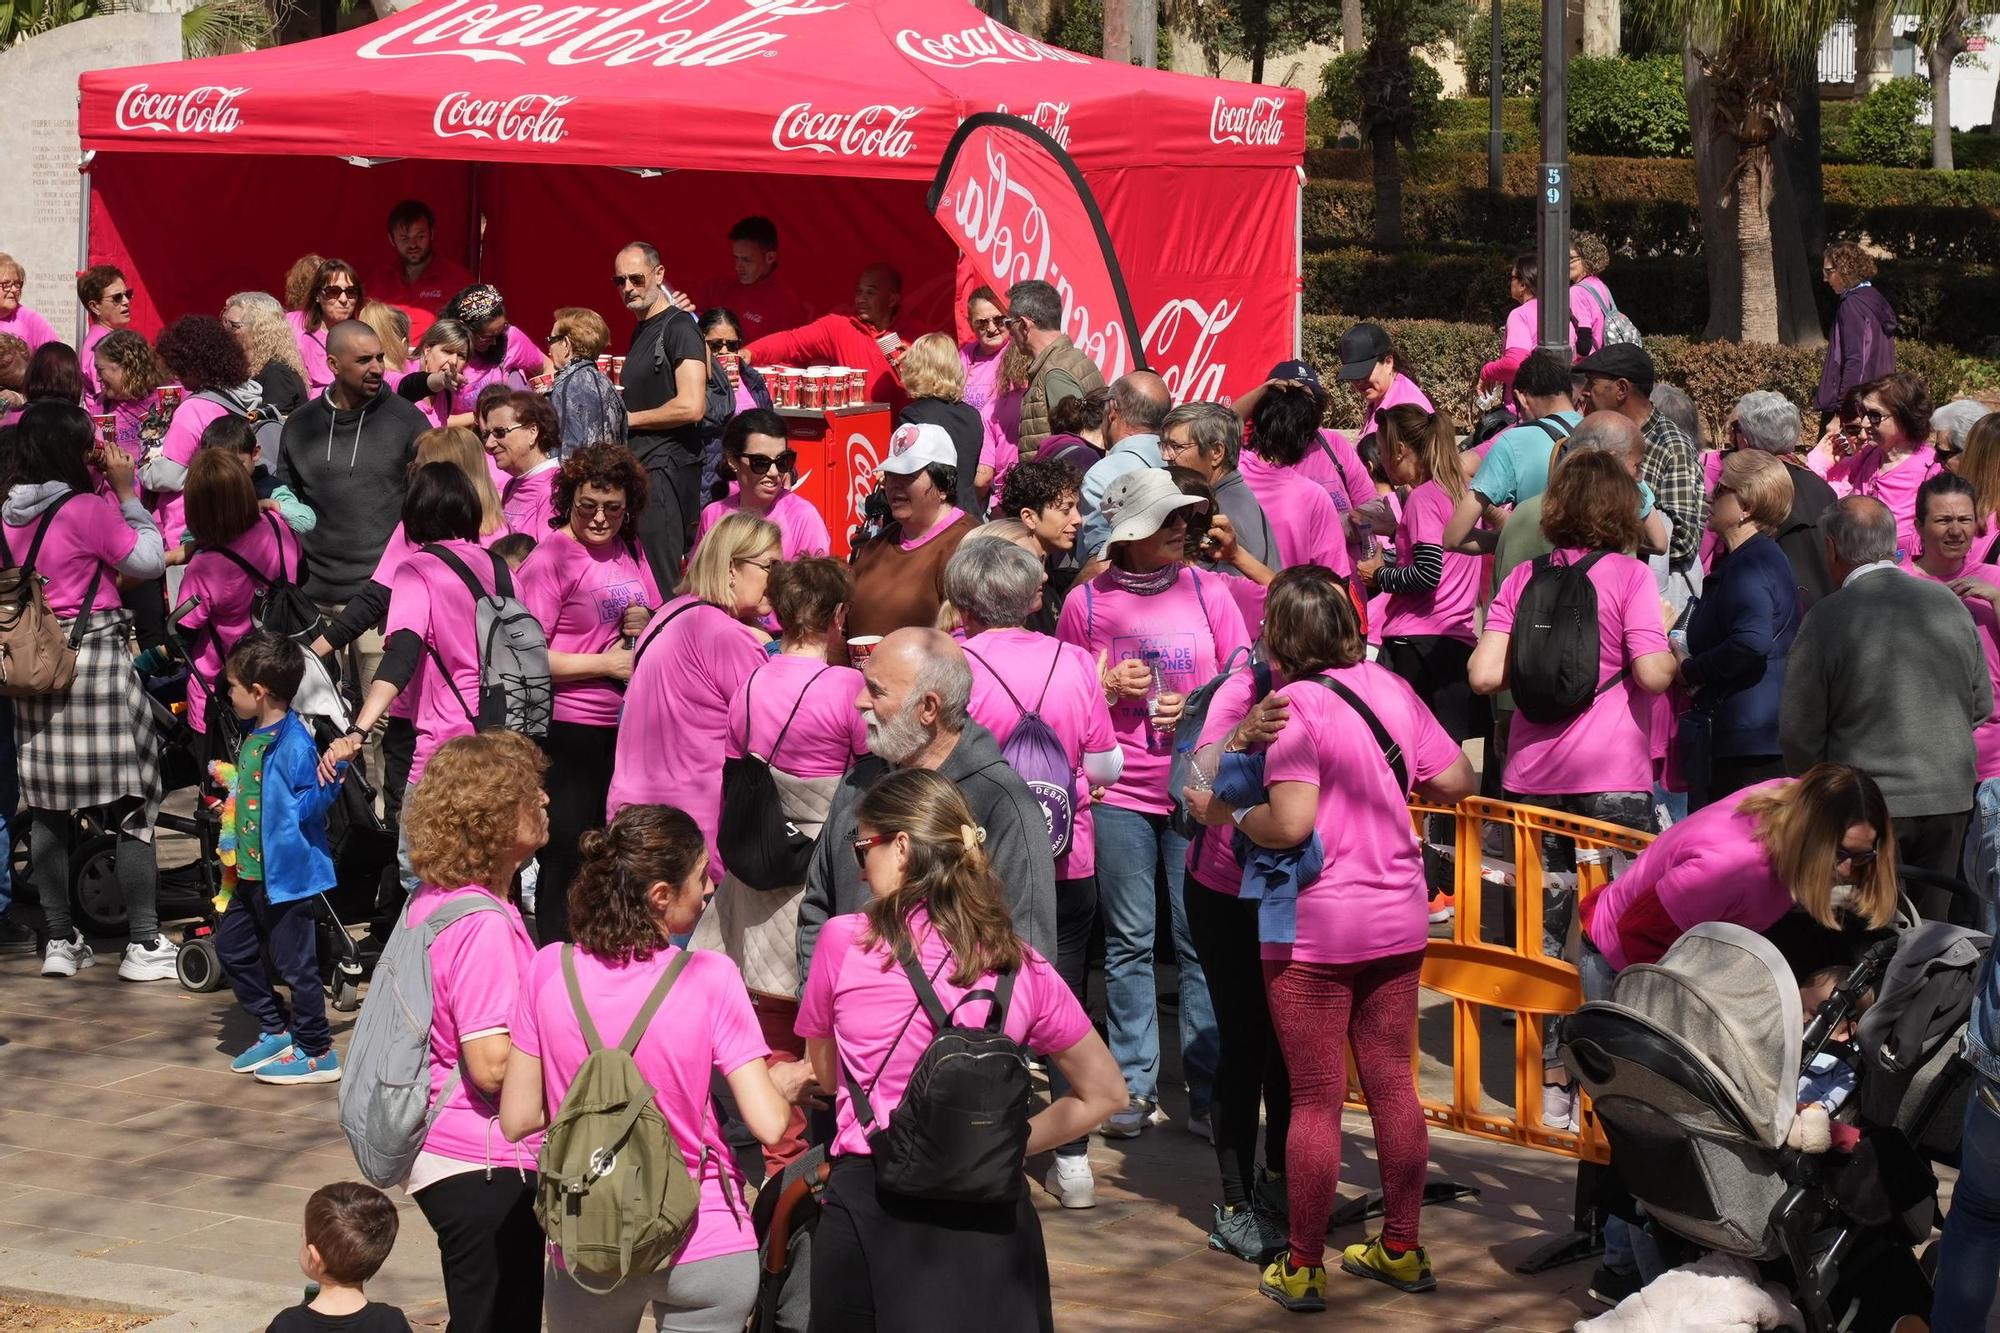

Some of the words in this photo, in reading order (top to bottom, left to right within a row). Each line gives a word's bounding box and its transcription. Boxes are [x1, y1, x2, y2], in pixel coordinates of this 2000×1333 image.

[356, 0, 790, 67] Coca-Cola
[115, 83, 252, 133] Coca-Cola
[433, 91, 578, 144] Coca-Cola
[772, 102, 926, 158] Coca-Cola
[1210, 95, 1285, 145] Coca-Cola
[609, 585, 631, 599] XVIII
[634, 591, 645, 602] DE
[602, 608, 620, 620] LES
[1121, 649, 1170, 662] CURA
[1174, 647, 1191, 659] DE
[1156, 659, 1193, 672] ONES
[1035, 786, 1067, 812] DEBATE
[1051, 833, 1064, 852] RAO
